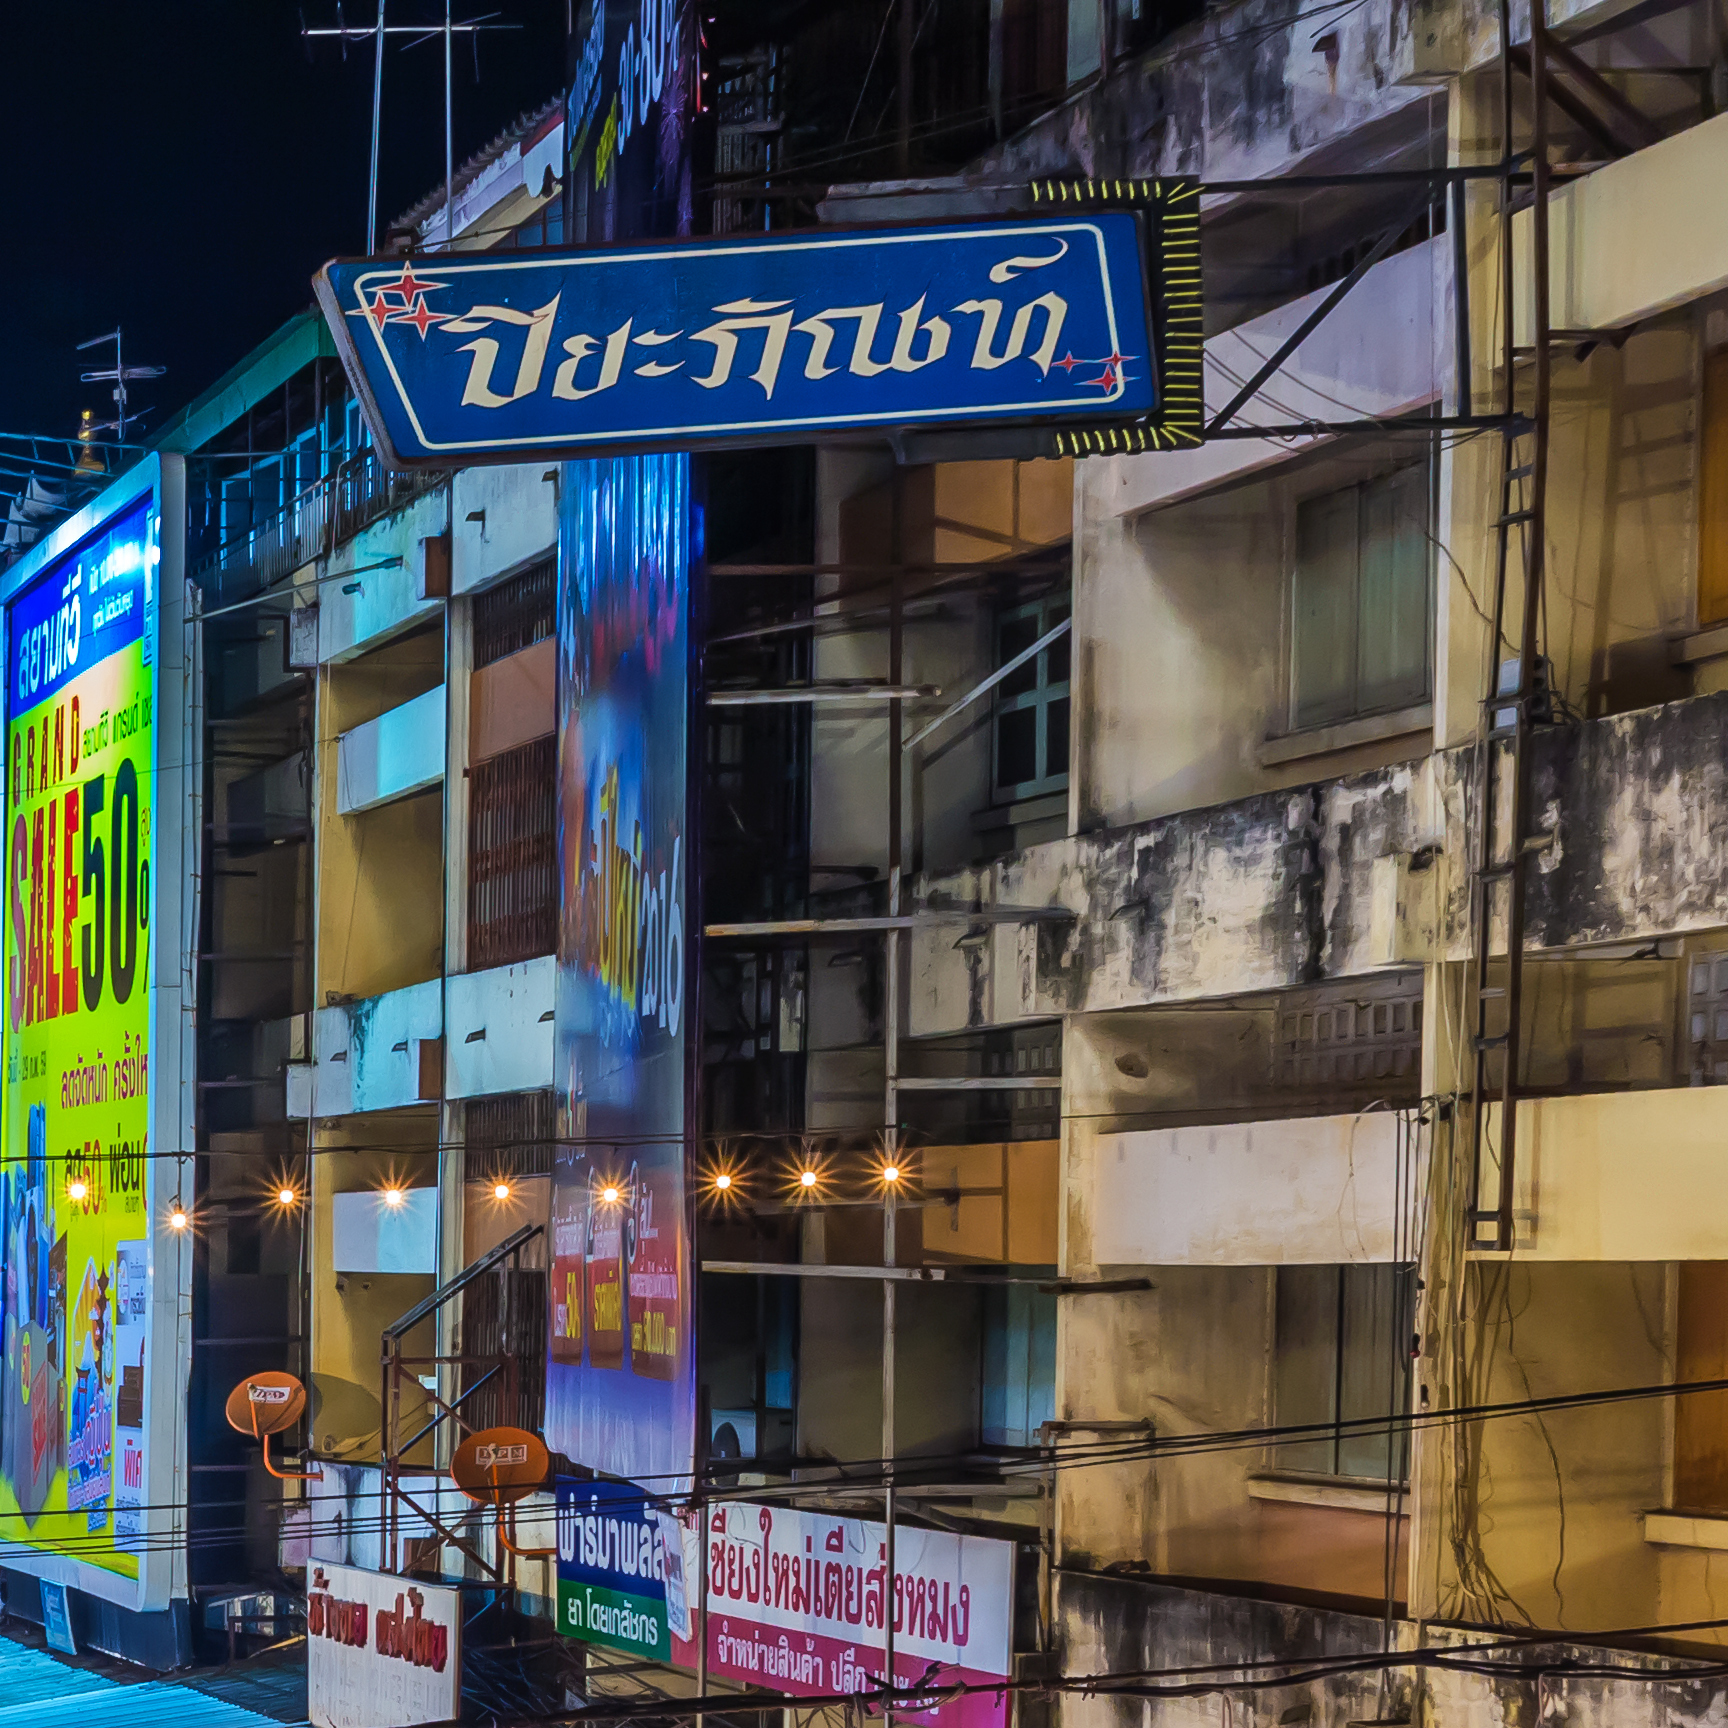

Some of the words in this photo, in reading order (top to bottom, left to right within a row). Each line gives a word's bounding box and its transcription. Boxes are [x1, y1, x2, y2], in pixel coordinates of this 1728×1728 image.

[13, 694, 81, 808] GRAND
[10, 787, 79, 1034] SALE
[707, 1506, 971, 1648] ชียงใหม่เตียส่งหมง
